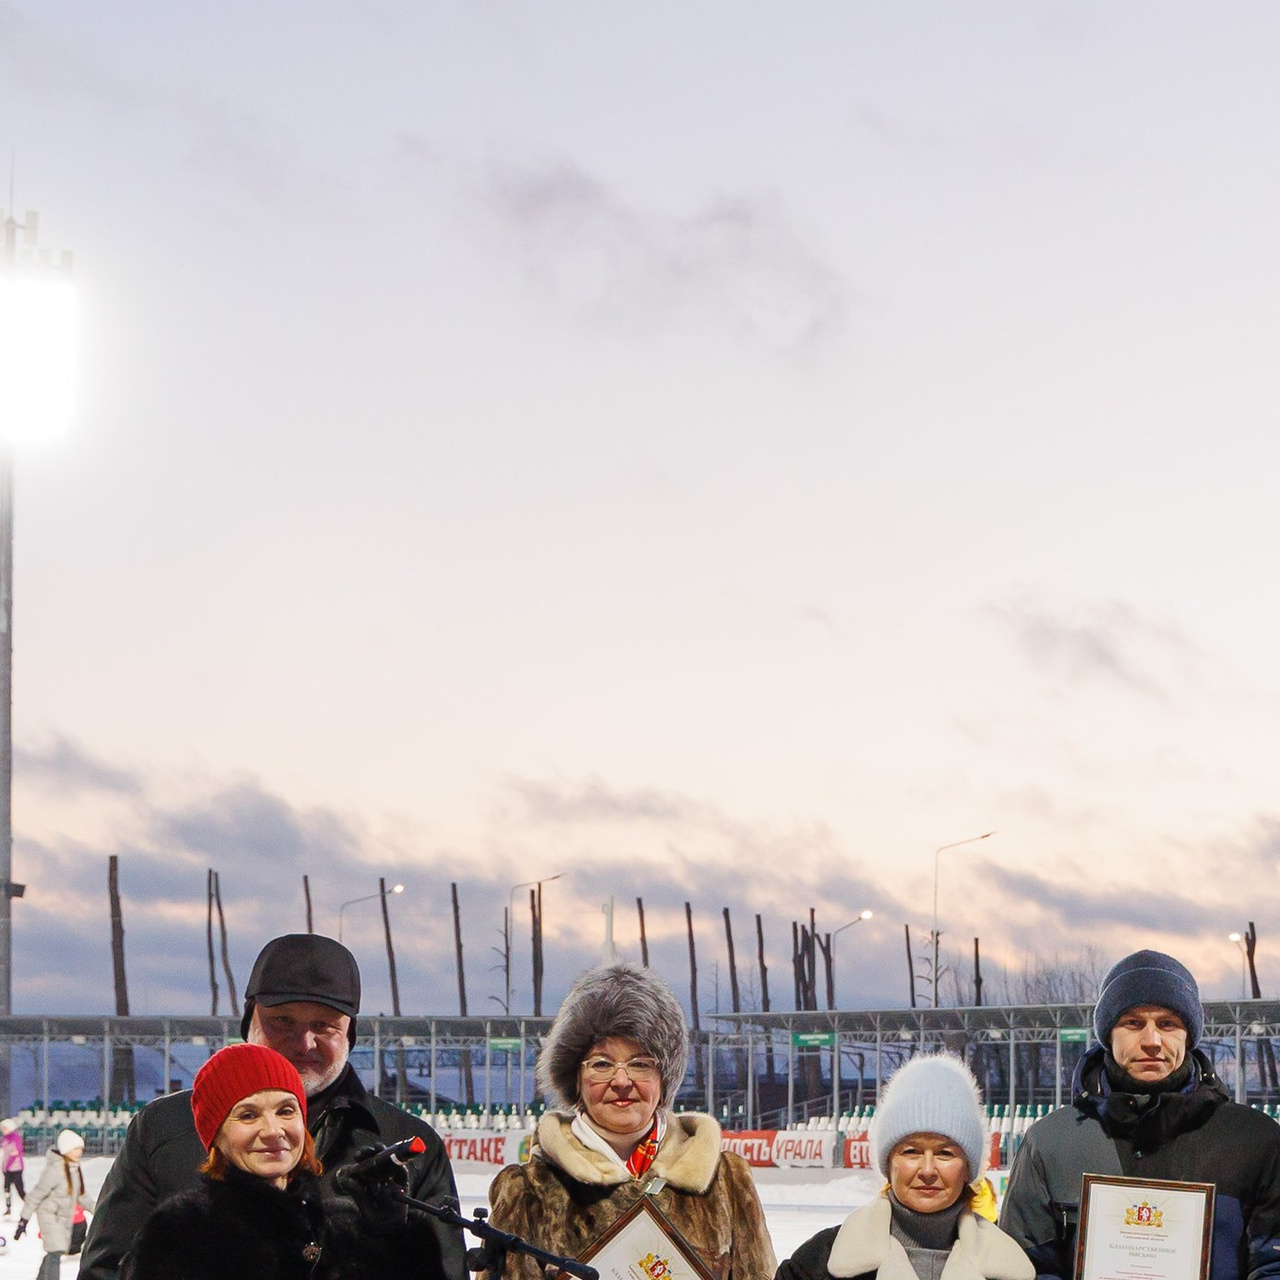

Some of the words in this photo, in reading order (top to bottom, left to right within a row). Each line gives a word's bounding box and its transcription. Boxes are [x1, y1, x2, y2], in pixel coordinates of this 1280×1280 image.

[444, 1133, 506, 1165] ЙТАНЕ
[775, 1139, 822, 1160] УРАЛА
[850, 1140, 870, 1163] ВТ
